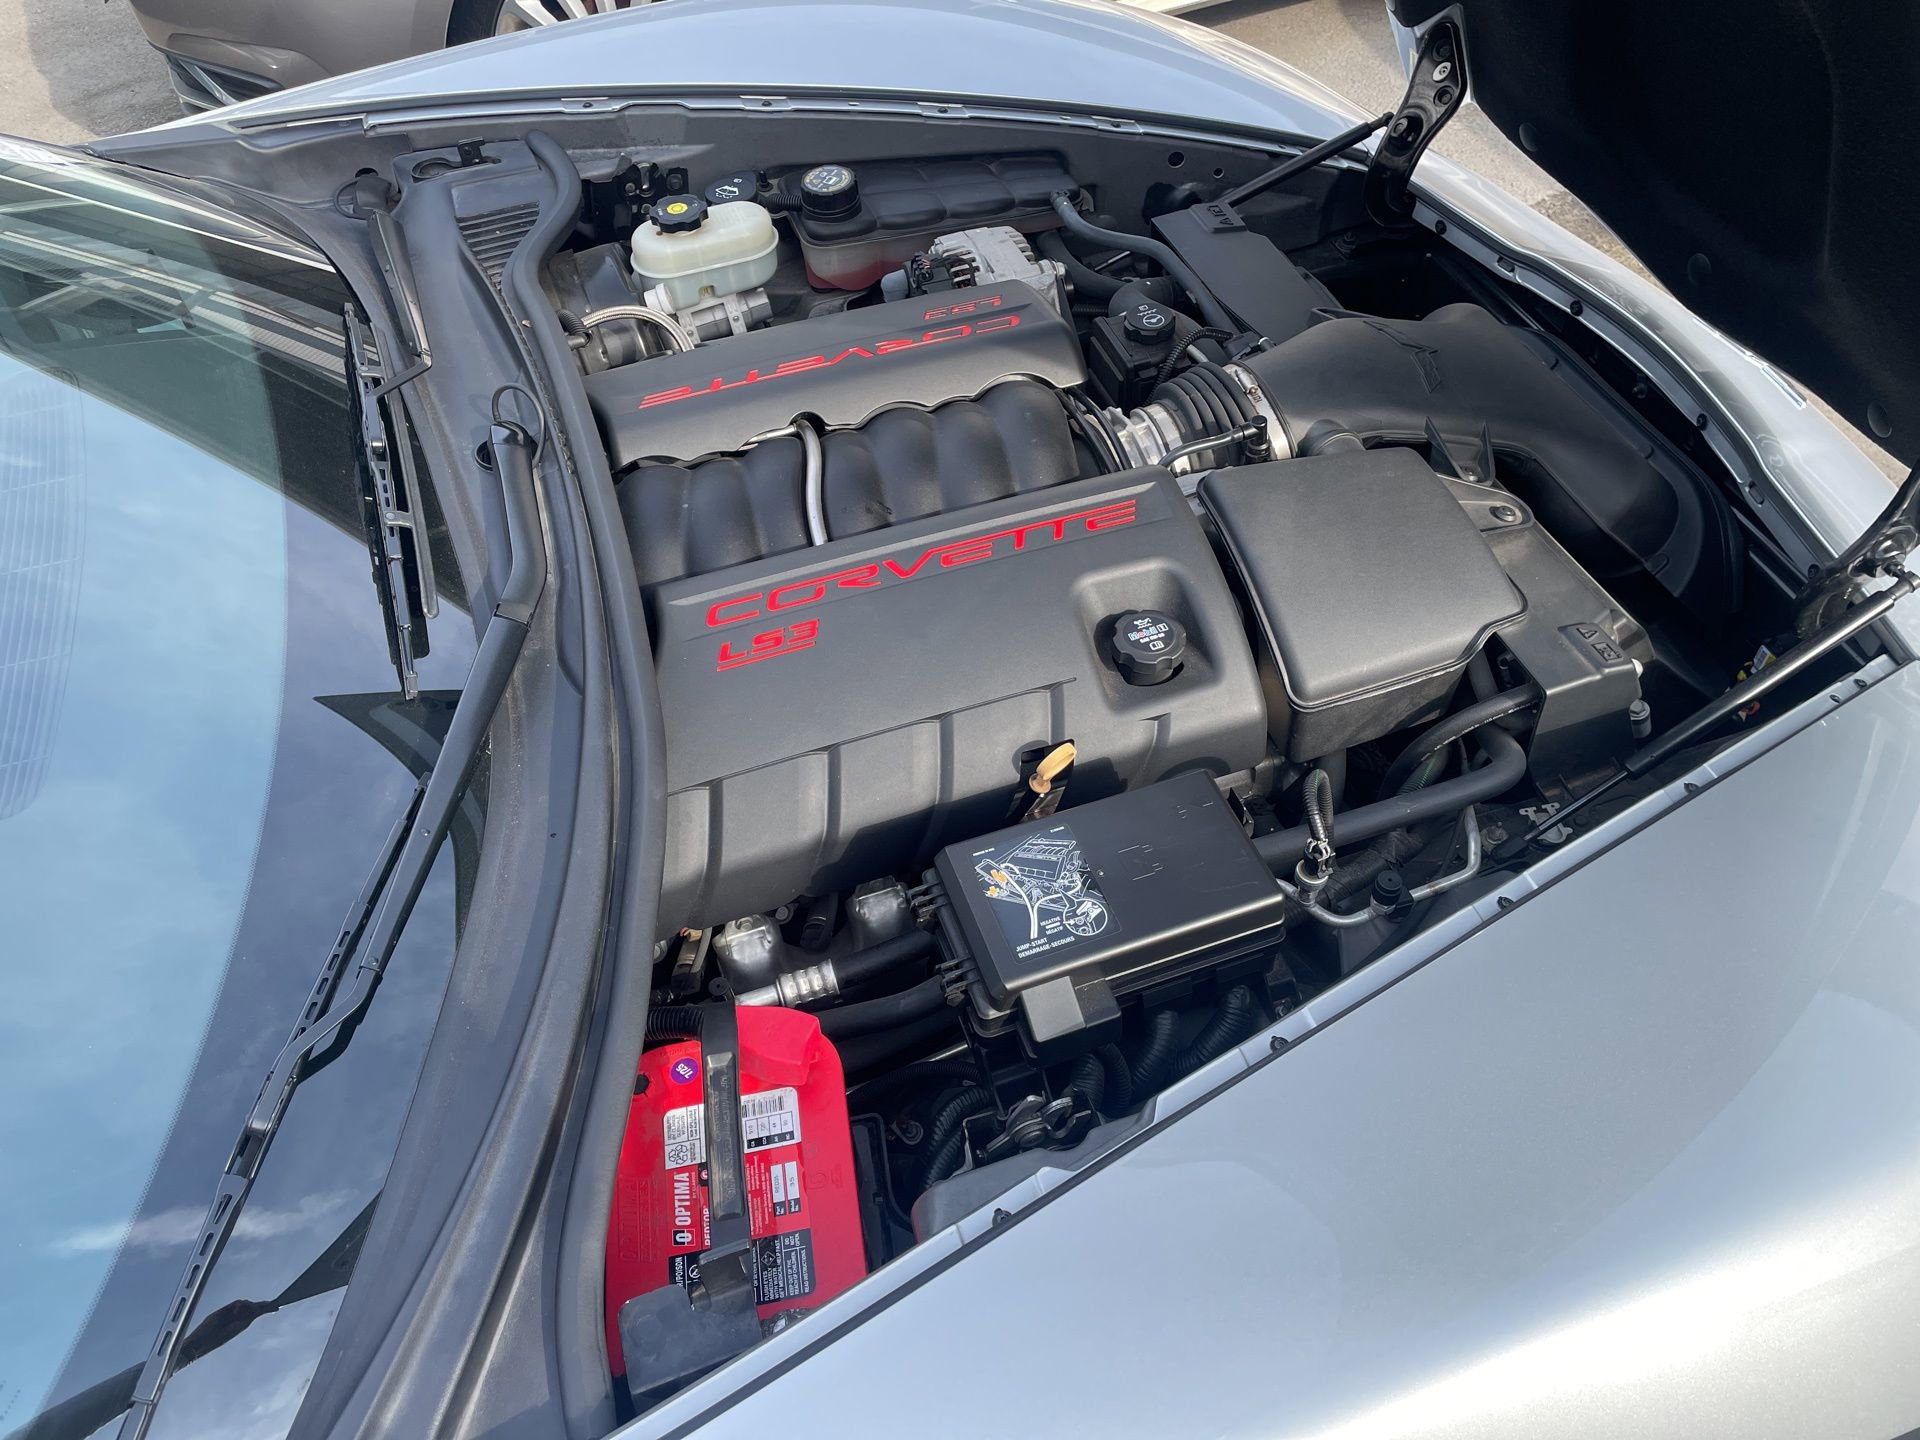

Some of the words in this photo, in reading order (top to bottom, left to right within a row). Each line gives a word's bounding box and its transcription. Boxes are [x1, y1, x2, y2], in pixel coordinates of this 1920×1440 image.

[924, 295, 1002, 320] LS3
[639, 313, 1020, 409] CORVETTE
[706, 499, 1137, 628] CORVETTE
[718, 618, 820, 665] LS3
[1040, 917, 1060, 926] NEGATIVE
[1016, 938, 1047, 952] JUMP-START
[676, 1063, 693, 1079] 7/25
[674, 1172, 691, 1226] OPTIMA
